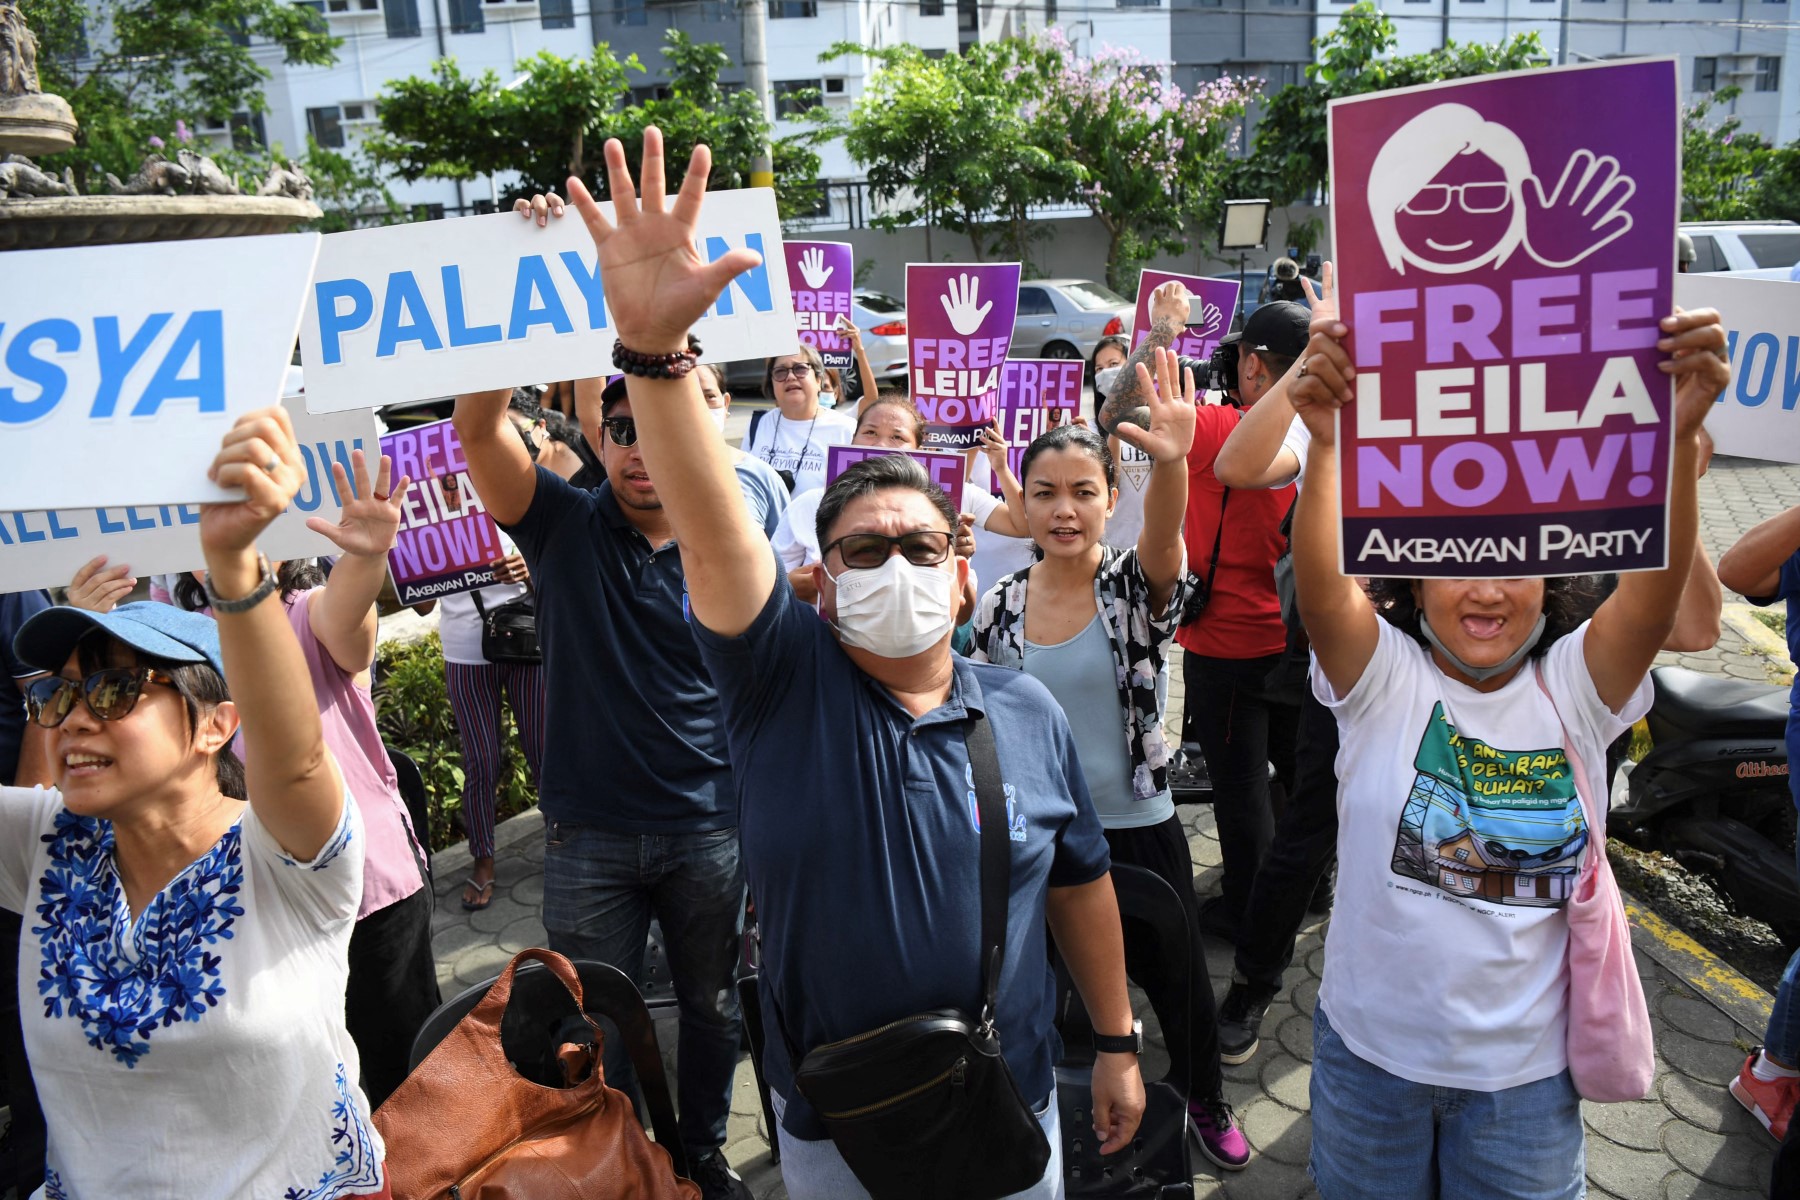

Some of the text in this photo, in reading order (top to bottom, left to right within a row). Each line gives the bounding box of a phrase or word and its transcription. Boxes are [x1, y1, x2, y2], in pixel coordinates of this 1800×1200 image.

[315, 233, 773, 365] PALAYN
[795, 311, 848, 331] EILA
[1354, 268, 1659, 367] FREE
[799, 331, 850, 350] OW!
[914, 336, 1009, 369] FREE
[0, 310, 226, 424] SYA
[823, 353, 850, 365] PARTY
[915, 366, 997, 397] LEILA
[1001, 363, 1079, 407] FREE
[1357, 356, 1660, 439] LEILA
[916, 390, 997, 424] NOW!
[1357, 432, 1656, 508] NOW!
[399, 472, 486, 531] EILA
[394, 514, 496, 579] NOW!
[1357, 524, 1653, 563] AKBAYAN PARTY
[405, 577, 463, 601] AKBAYAN
[1736, 760, 1789, 779] Althea
[1473, 779, 1545, 796] BUHAY?
[1513, 796, 1538, 806] paligid
[1539, 799, 1549, 807] ng
